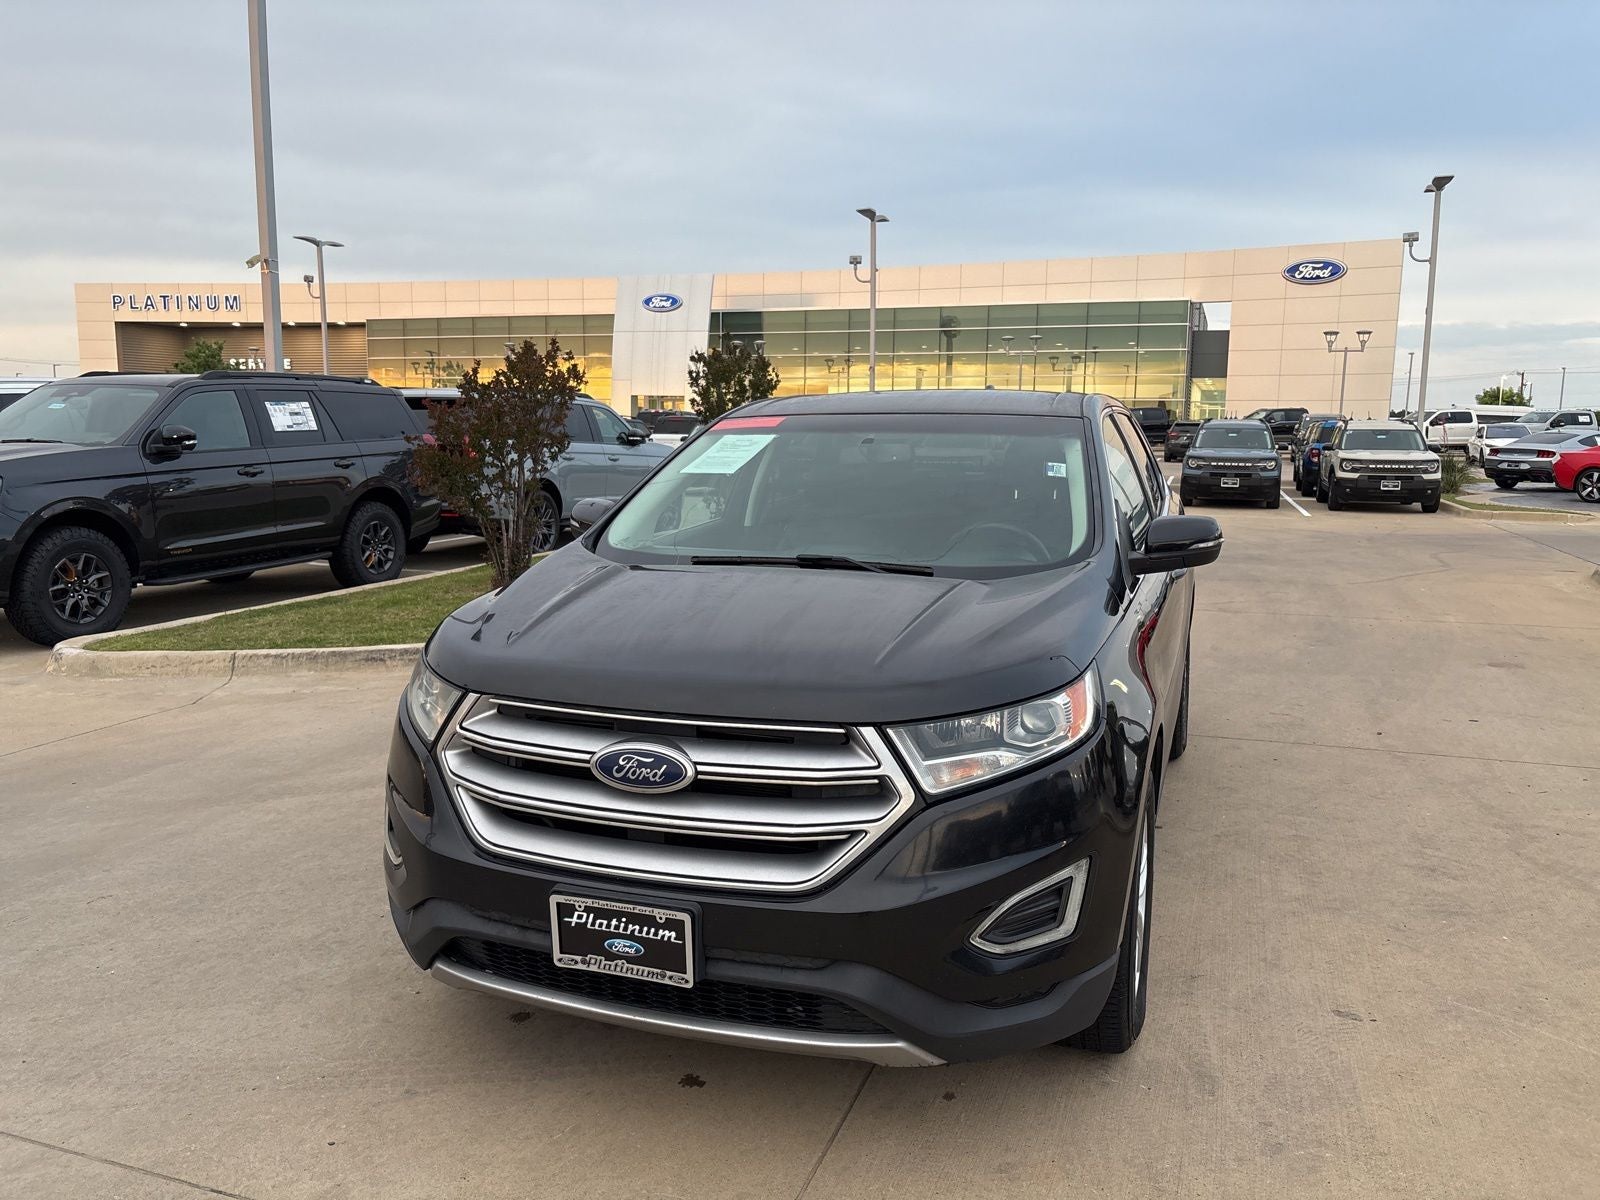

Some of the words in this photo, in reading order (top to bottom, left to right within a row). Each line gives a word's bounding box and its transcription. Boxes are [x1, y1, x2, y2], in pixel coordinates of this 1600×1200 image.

[1295, 263, 1333, 279] Ford
[111, 294, 241, 311] PLATINUM
[649, 296, 673, 308] Ford
[229, 358, 292, 370] SERVE
[612, 754, 667, 782] Ford
[563, 897, 677, 918] www.PlatinumFord.com
[563, 911, 683, 944] Platinum
[611, 941, 637, 955] Ford
[587, 956, 660, 980] Platinum
